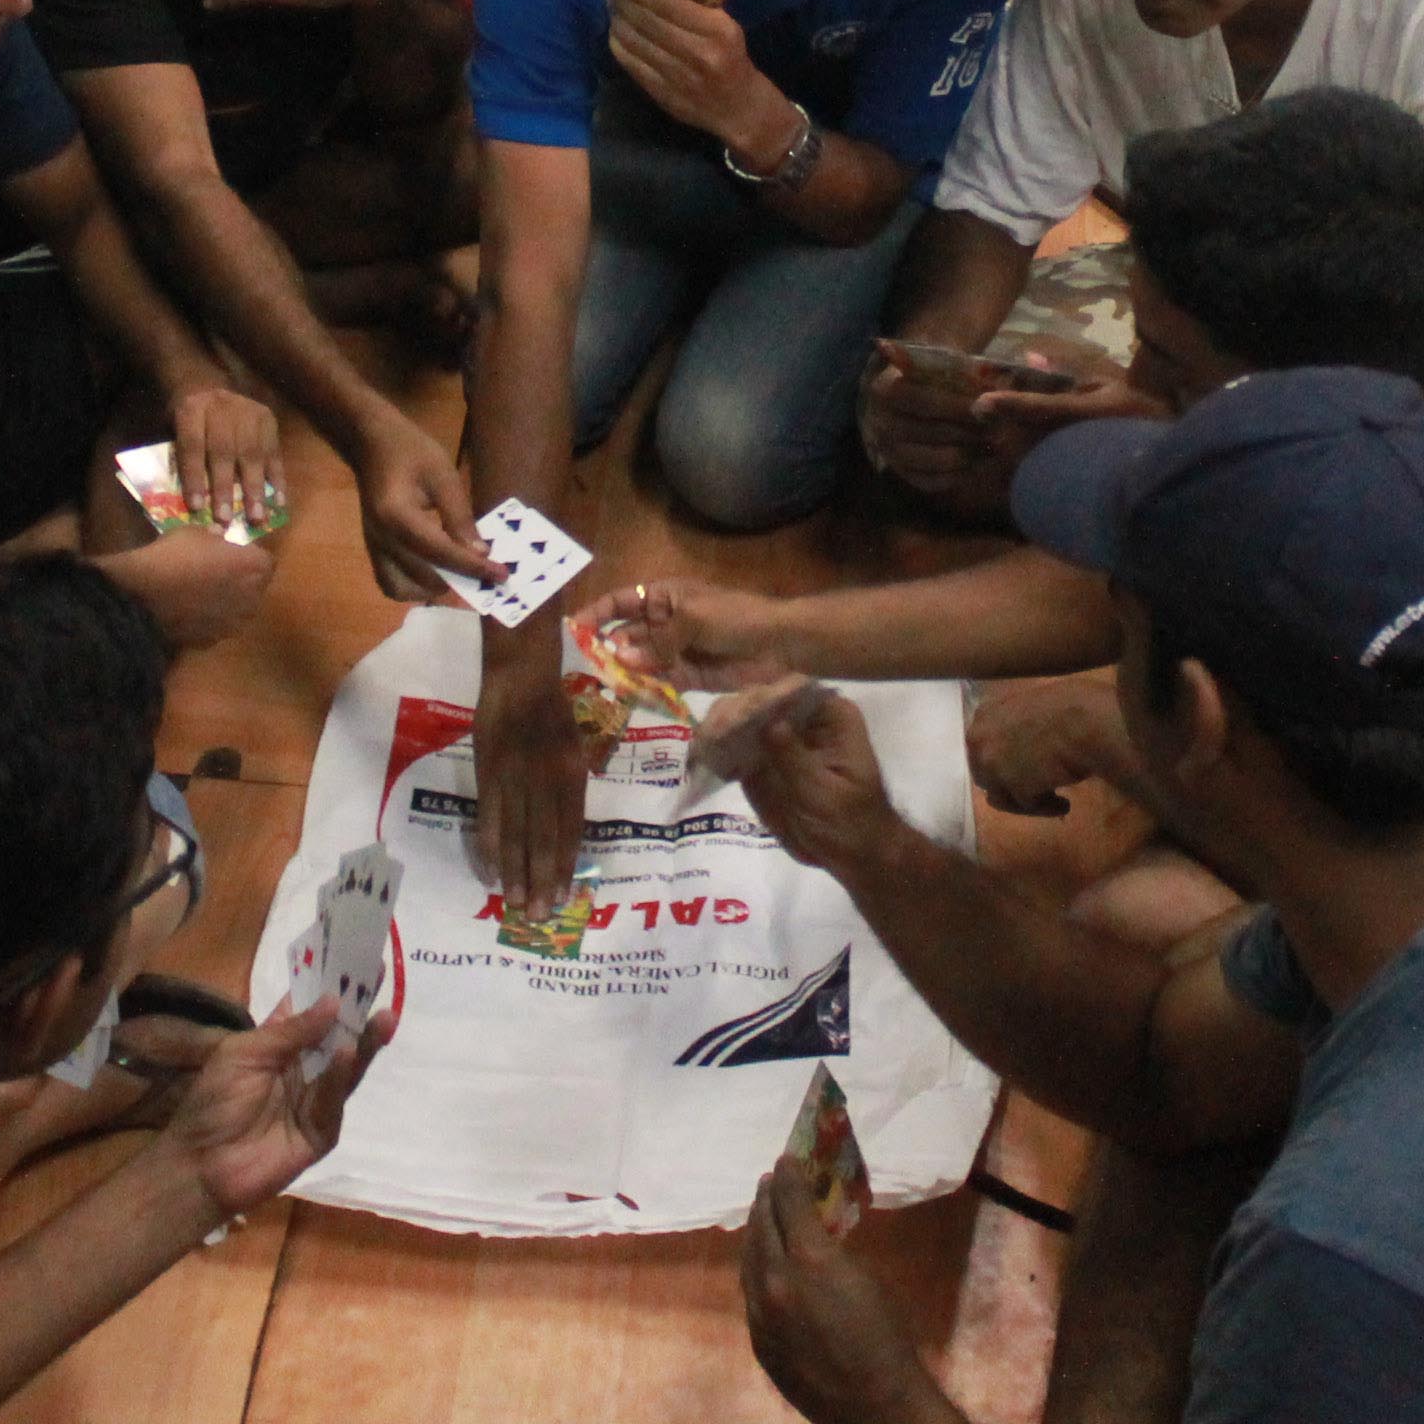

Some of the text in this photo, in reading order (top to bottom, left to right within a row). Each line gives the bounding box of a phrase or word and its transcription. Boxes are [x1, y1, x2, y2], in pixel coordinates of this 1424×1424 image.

[473, 893, 750, 933] GALAY
[409, 947, 493, 968] LAPTOP
[497, 955, 515, 969] &
[519, 960, 602, 982] MOBILE
[528, 976, 670, 997] MULTI BRAND
